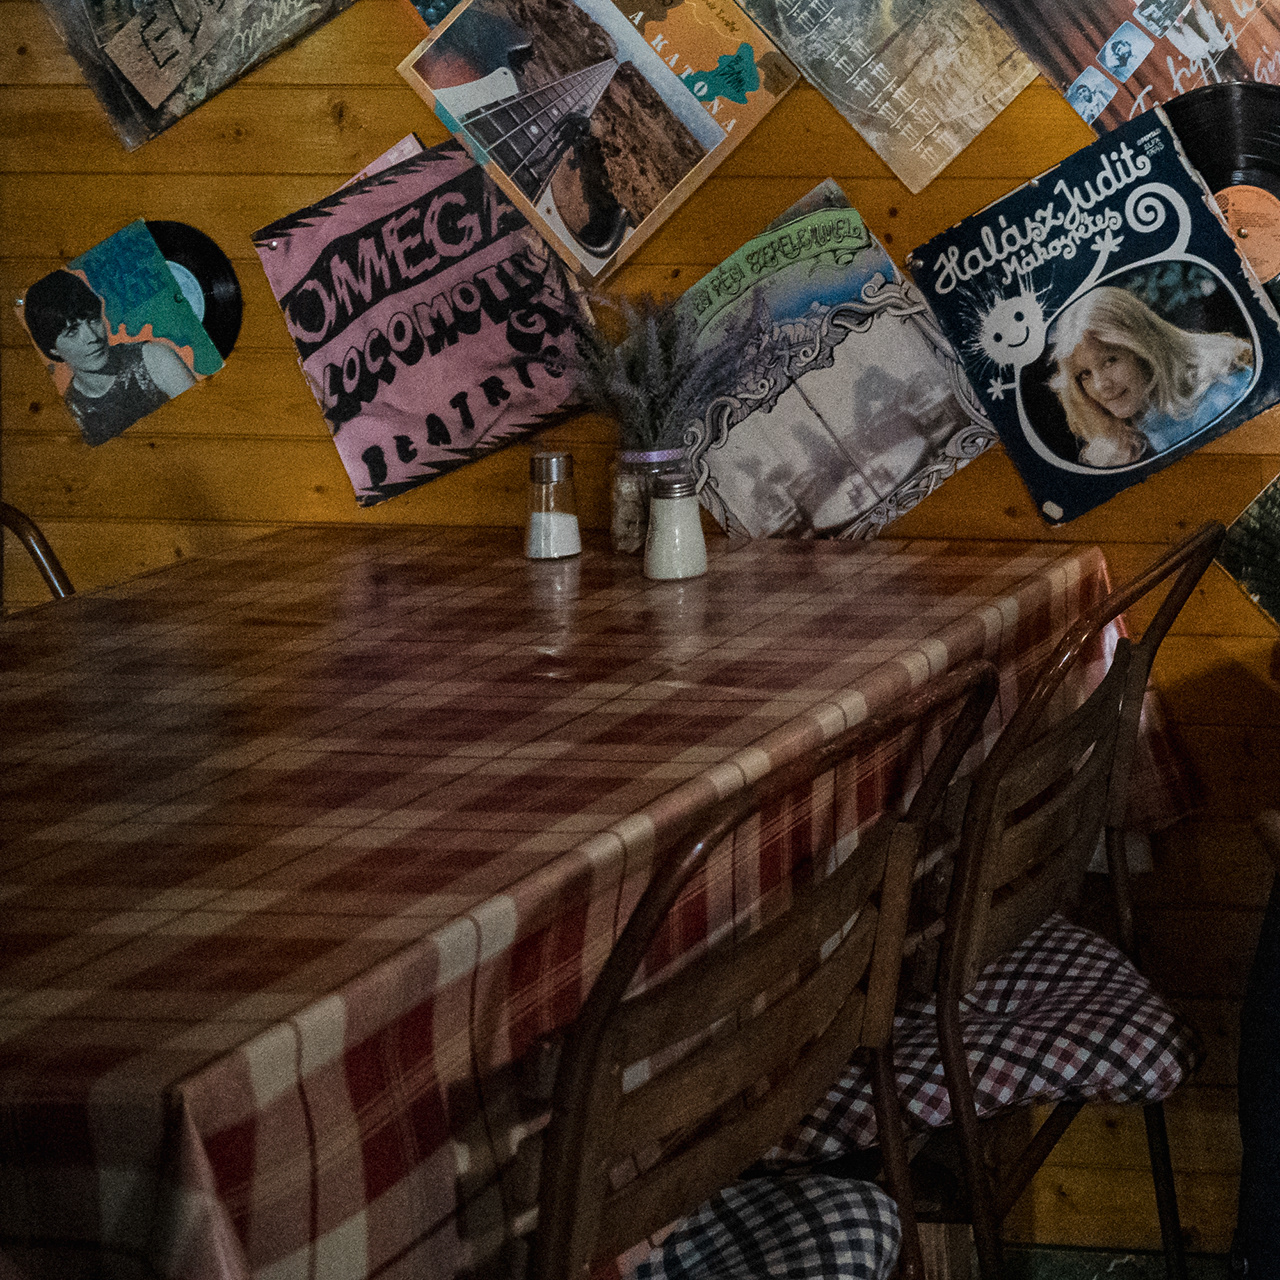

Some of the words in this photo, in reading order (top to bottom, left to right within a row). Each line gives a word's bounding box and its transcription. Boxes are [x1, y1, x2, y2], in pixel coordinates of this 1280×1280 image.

[628, 10, 645, 26] A
[650, 33, 737, 133] KATONA
[935, 198, 1065, 294] Halász
[1056, 141, 1151, 221] Judit
